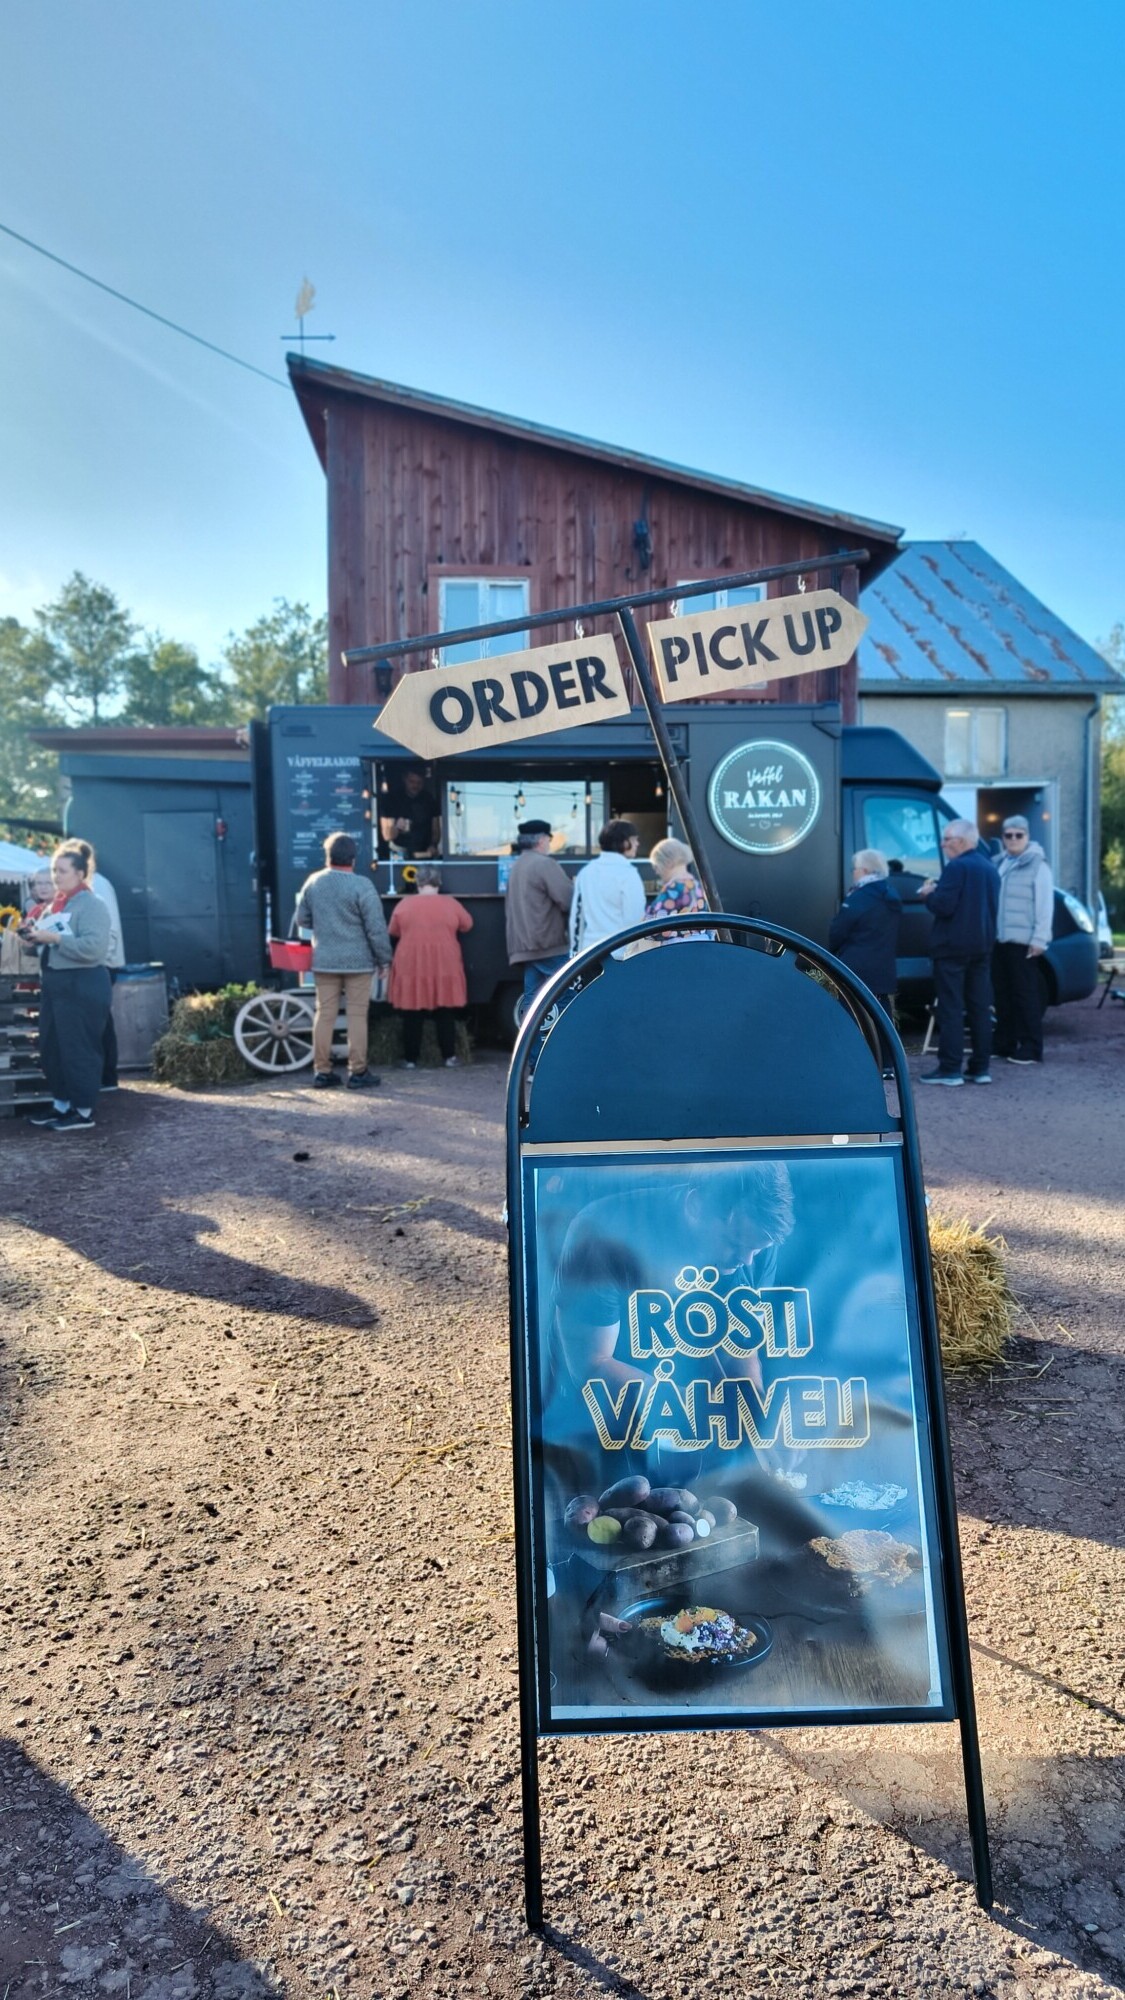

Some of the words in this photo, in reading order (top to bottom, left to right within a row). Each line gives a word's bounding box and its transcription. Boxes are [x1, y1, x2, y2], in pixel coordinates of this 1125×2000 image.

[661, 619, 778, 683] PICK
[784, 606, 843, 656] UP
[429, 657, 617, 735] ORDER
[723, 789, 806, 808] RAKAN
[629, 1265, 814, 1358] RÖSTI
[582, 1359, 870, 1450] VÅHVELI
